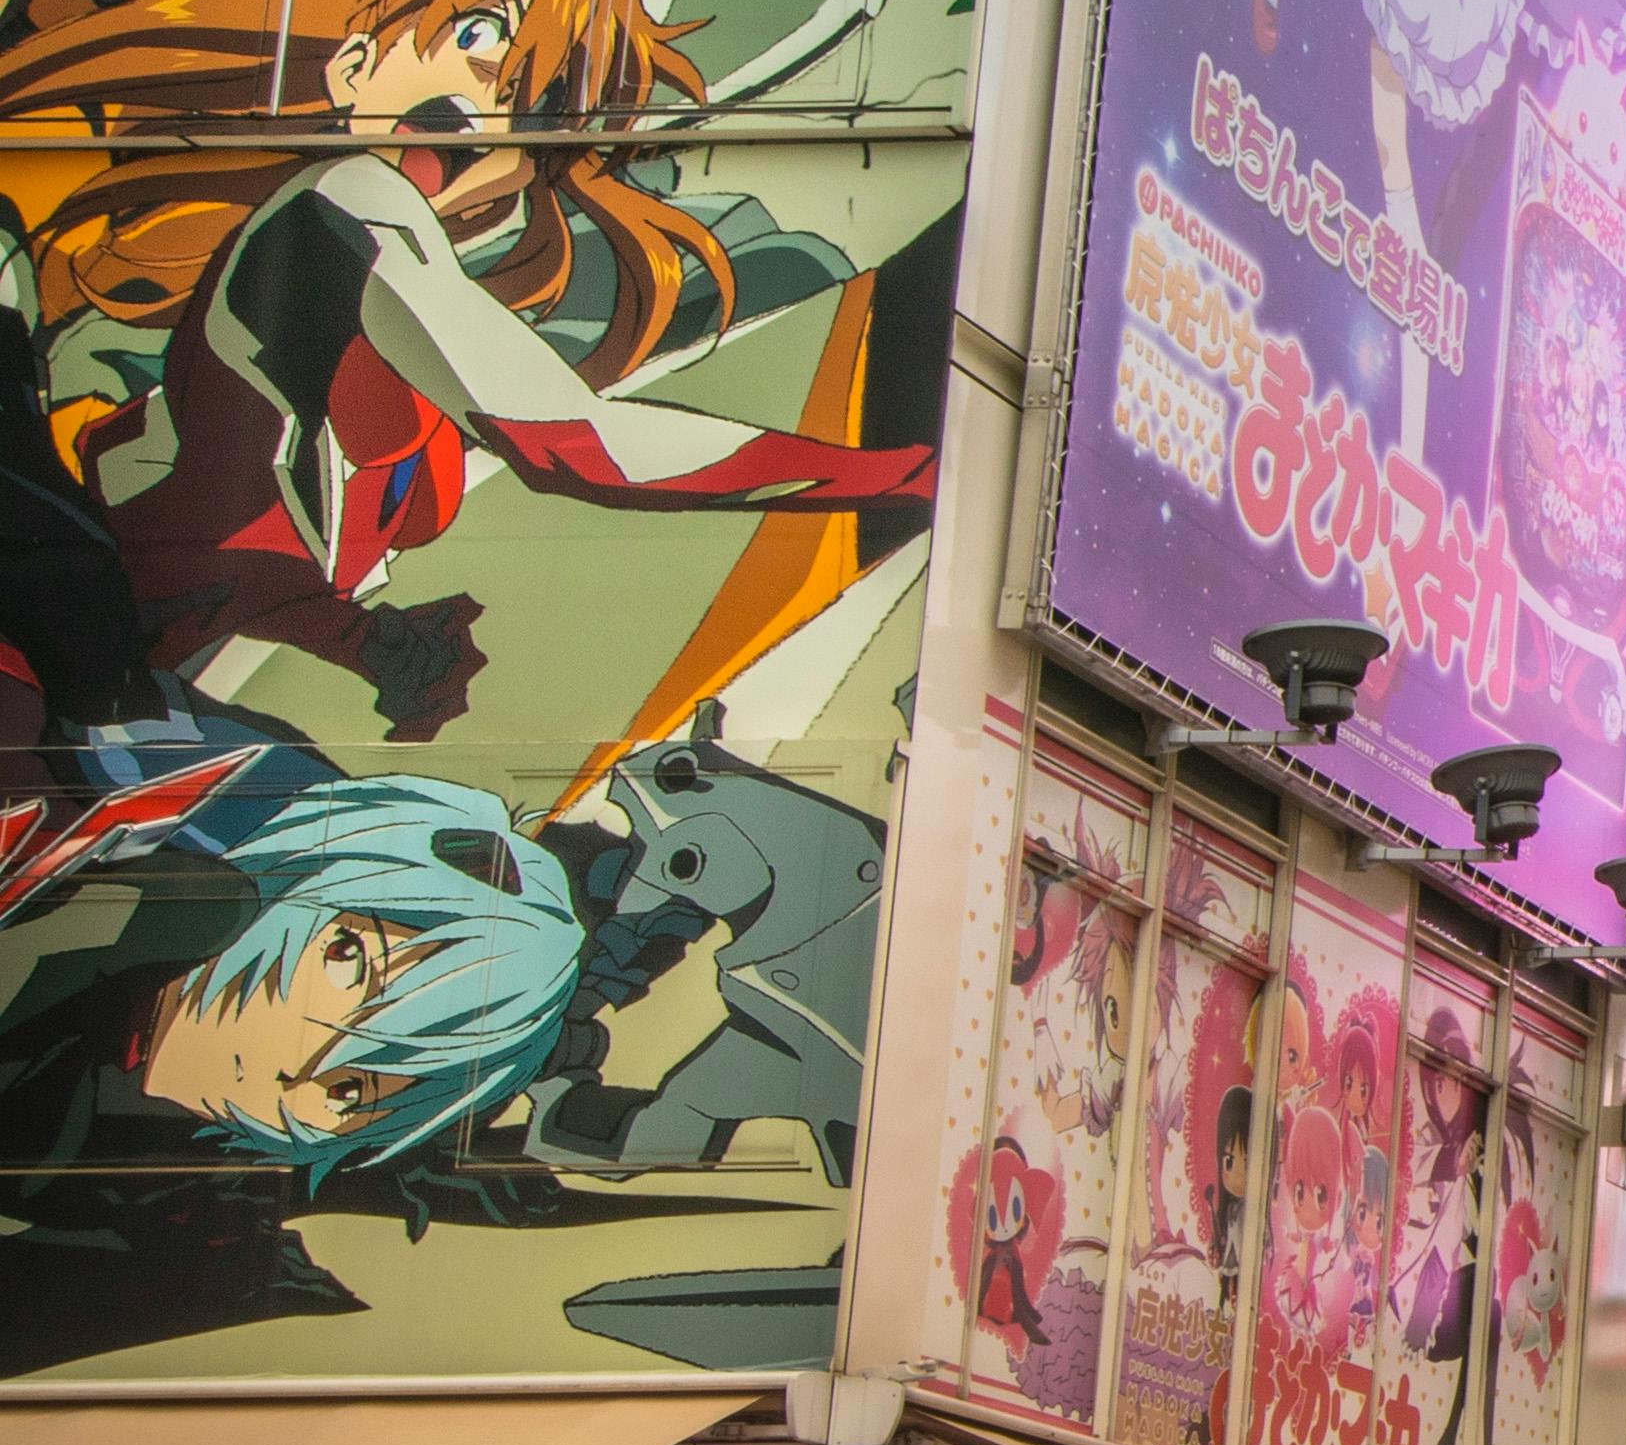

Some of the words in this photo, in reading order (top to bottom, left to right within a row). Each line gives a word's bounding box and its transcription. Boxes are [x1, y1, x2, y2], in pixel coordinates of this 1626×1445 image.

[1158, 183, 1266, 301] PACHINKO
[1191, 51, 1470, 379] ぱちんこで登場!!
[1113, 403, 1224, 502] MAGICA
[1118, 363, 1226, 458] MADOKA
